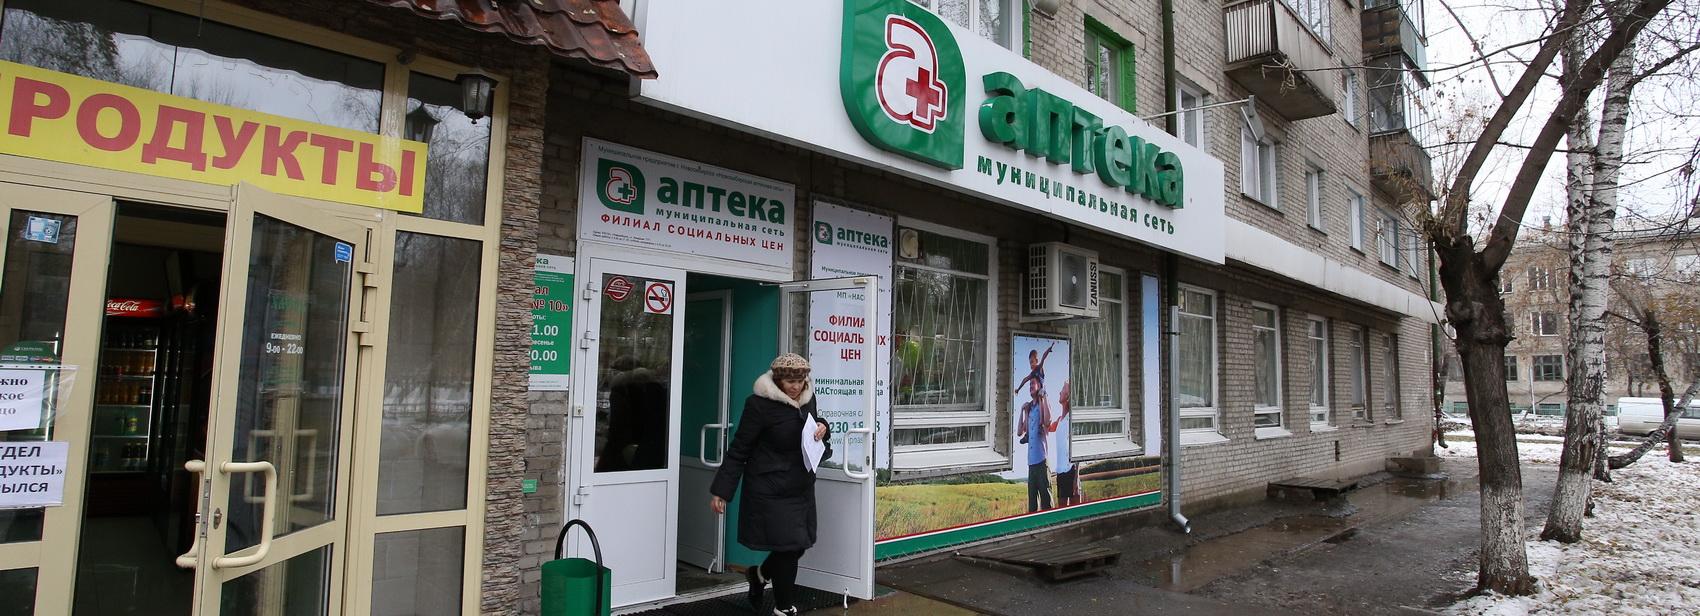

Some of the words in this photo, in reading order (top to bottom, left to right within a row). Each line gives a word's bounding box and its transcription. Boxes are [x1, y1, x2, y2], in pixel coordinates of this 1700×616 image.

[0, 72, 417, 197] РОДУКТЫ
[978, 71, 1184, 209] аптека
[657, 177, 785, 225] аптека
[976, 155, 1138, 222] муниципальная
[1144, 213, 1175, 235] сеть
[656, 208, 758, 232] муниципальная
[761, 226, 785, 237] сеть
[601, 214, 661, 231] ФИЛИАЛ
[667, 224, 756, 247] СОЦИАЛЬНЫХ
[761, 240, 784, 251] ЦЕН
[837, 227, 888, 248] аптека
[837, 291, 847, 299] МП
[829, 315, 865, 328] ФИЛИА
[530, 325, 559, 336] 1.00
[529, 350, 558, 361] 0.00
[841, 349, 861, 361] ЦЕН
[815, 378, 864, 386] минимальная
[815, 387, 857, 397] НАСтоящая
[0, 482, 49, 493] ЫЛСЯ
